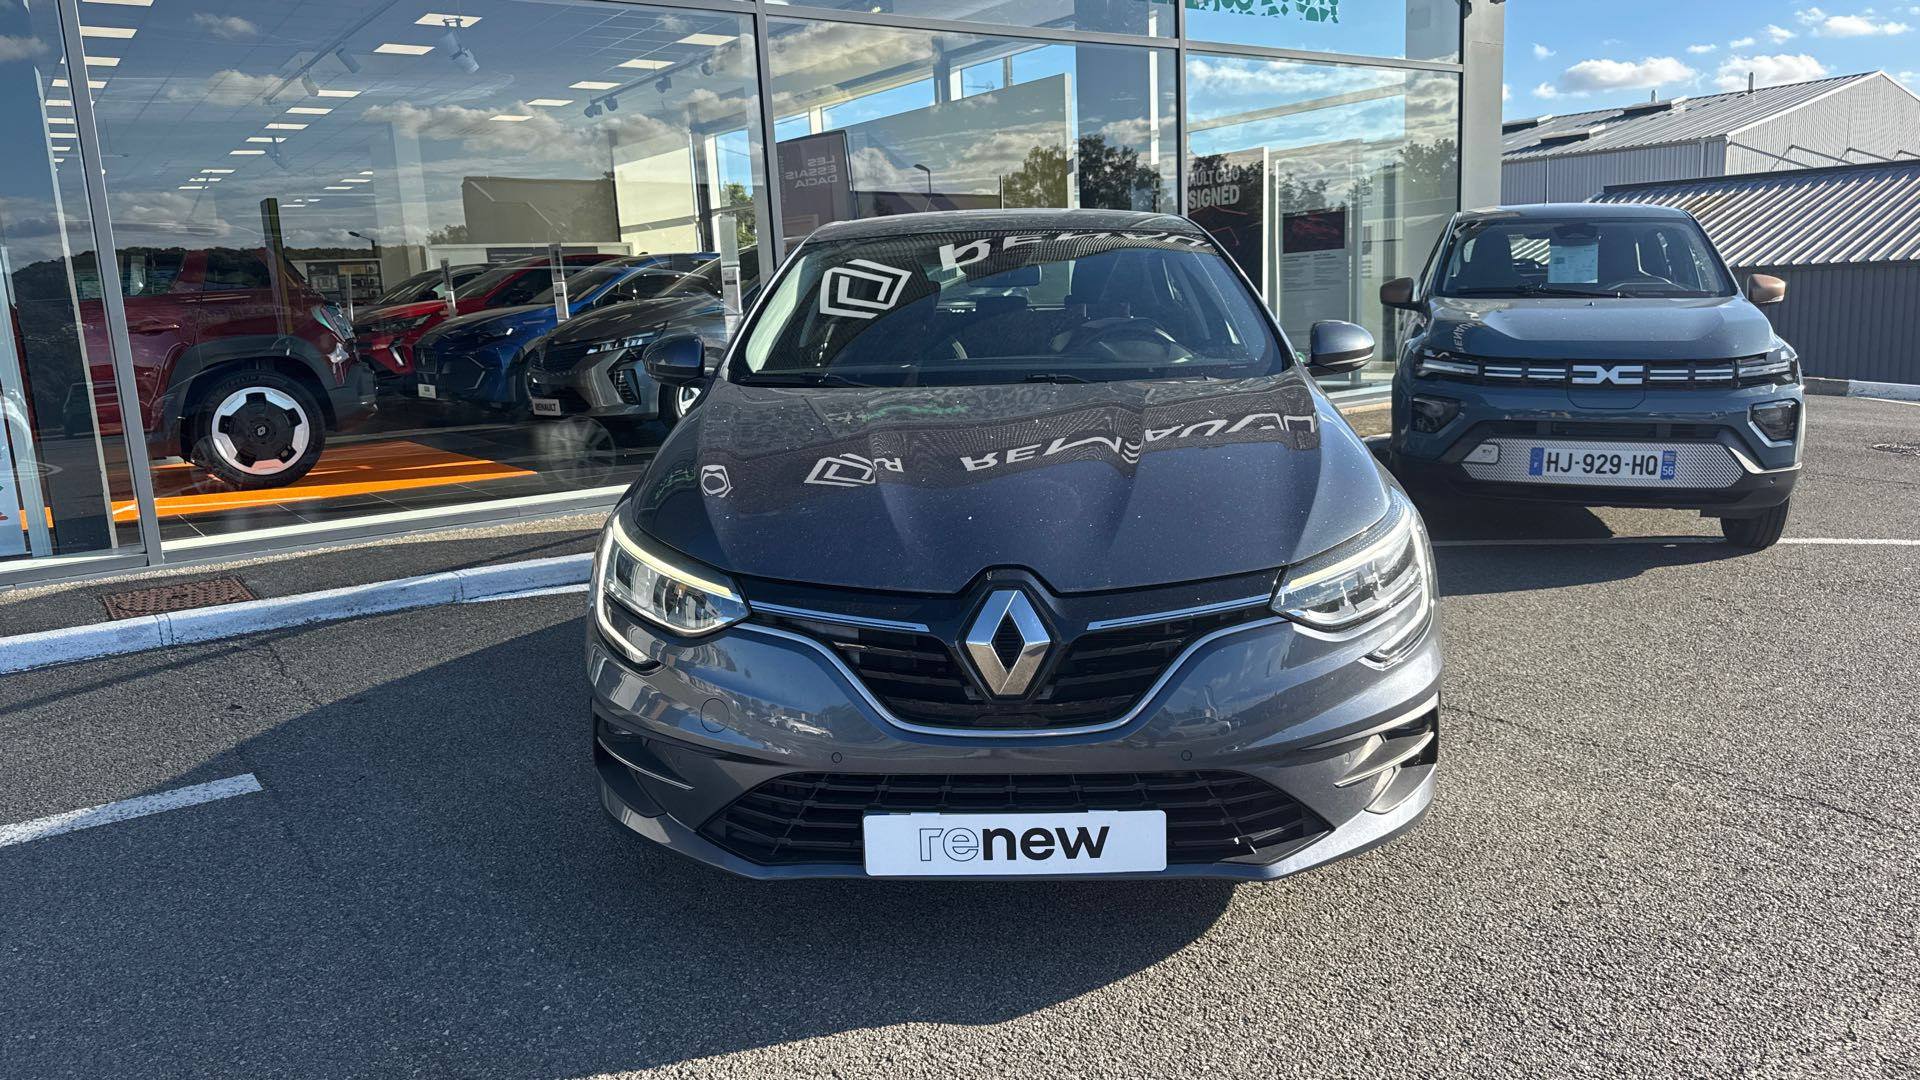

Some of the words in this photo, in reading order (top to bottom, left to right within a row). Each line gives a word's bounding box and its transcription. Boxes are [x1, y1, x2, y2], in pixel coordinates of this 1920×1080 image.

[1546, 452, 1658, 475] HJ-929-HQ
[1662, 464, 1674, 476] 56
[919, 825, 1110, 862] renew
